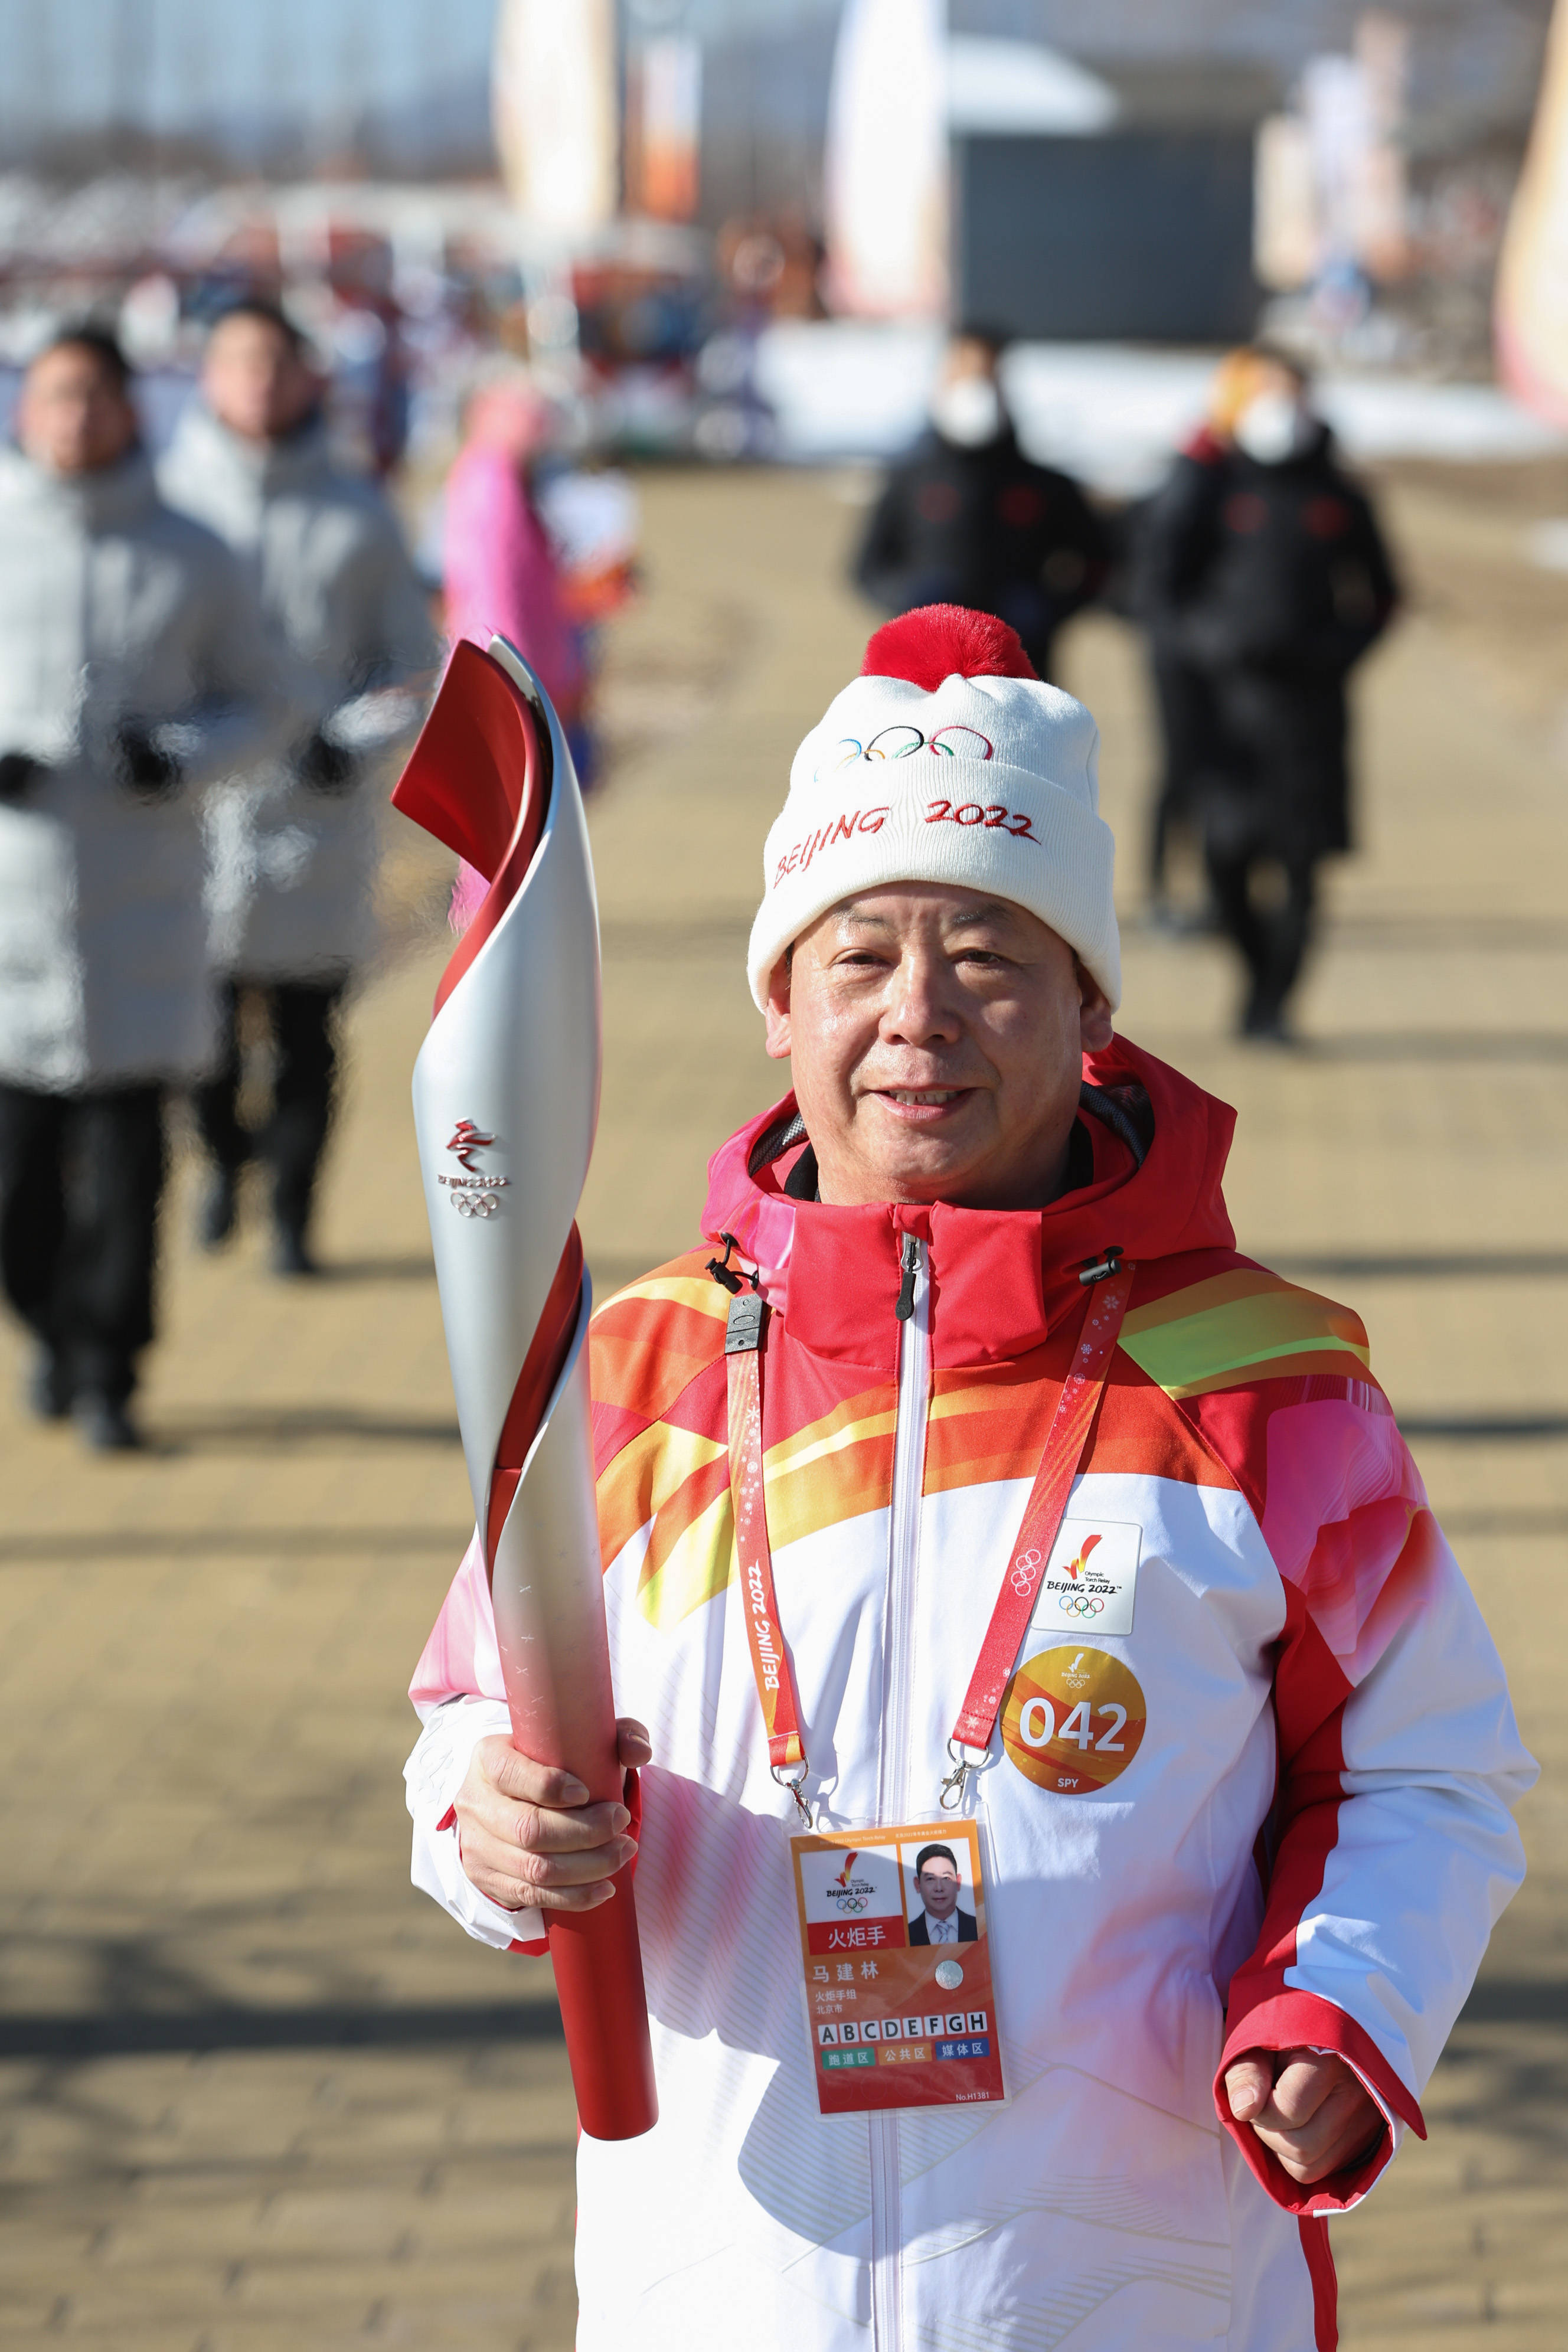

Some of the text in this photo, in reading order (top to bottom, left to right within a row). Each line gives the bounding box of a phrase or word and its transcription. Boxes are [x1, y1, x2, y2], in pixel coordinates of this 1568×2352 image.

[773, 800, 1042, 889] BEIJING 2022
[1047, 1580, 1085, 1593] BEIJING
[1088, 1584, 1118, 1594] 2022
[748, 1558, 780, 1691] BEIJING 2022
[1020, 1697, 1128, 1752] 042
[1057, 1778, 1079, 1788] SPY
[827, 1889, 853, 1897] BEIJING
[828, 1925, 886, 1949] 火炬手
[813, 1960, 878, 1982] 马建林
[815, 1988, 857, 2003] 火炬手组
[816, 2004, 842, 2014] 北京市
[828, 2043, 983, 2066] 跑道区 公共区 媒体区
[956, 2092, 989, 2101] No.H1381
